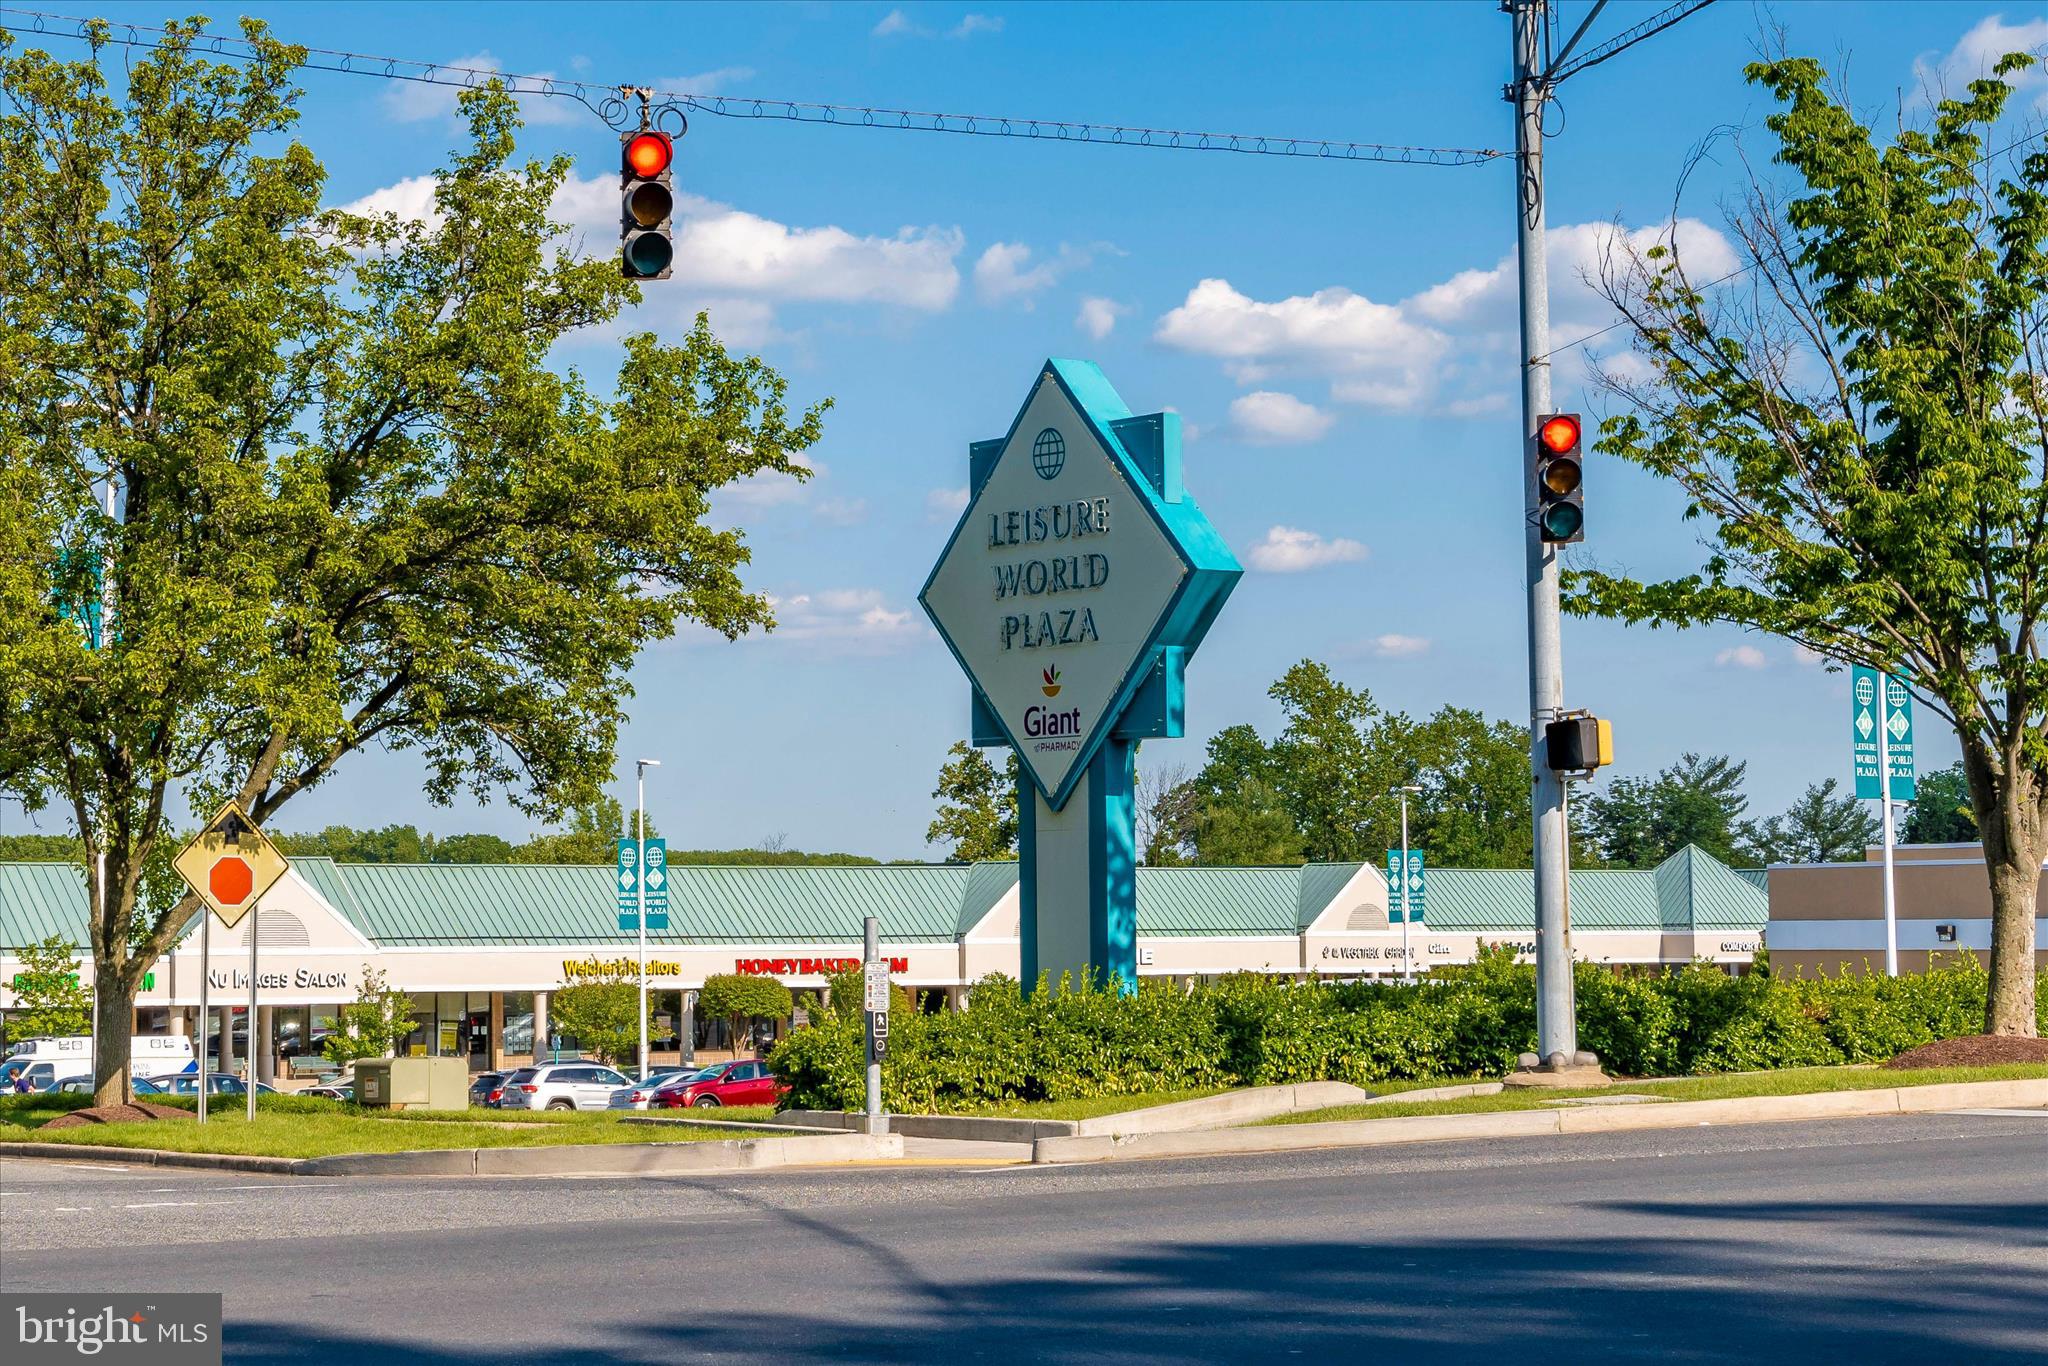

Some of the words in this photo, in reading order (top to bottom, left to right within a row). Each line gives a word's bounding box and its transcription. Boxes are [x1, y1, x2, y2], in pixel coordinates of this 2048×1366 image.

[988, 498, 1110, 548] LEISURE
[991, 553, 1109, 601] WORLD
[1001, 607, 1099, 651] PLAZA
[1024, 705, 1081, 737] Giant
[1893, 719, 1906, 731] 10
[1040, 740, 1081, 752] PHARMACY
[1855, 742, 1877, 751] LEISURE
[1855, 754, 1877, 764] WORLD
[1888, 755, 1913, 765] WORLD
[1856, 767, 1878, 777] PLAZA
[1888, 768, 1913, 777] PLAZA
[650, 874, 661, 884] 10
[645, 898, 667, 906] WORLD
